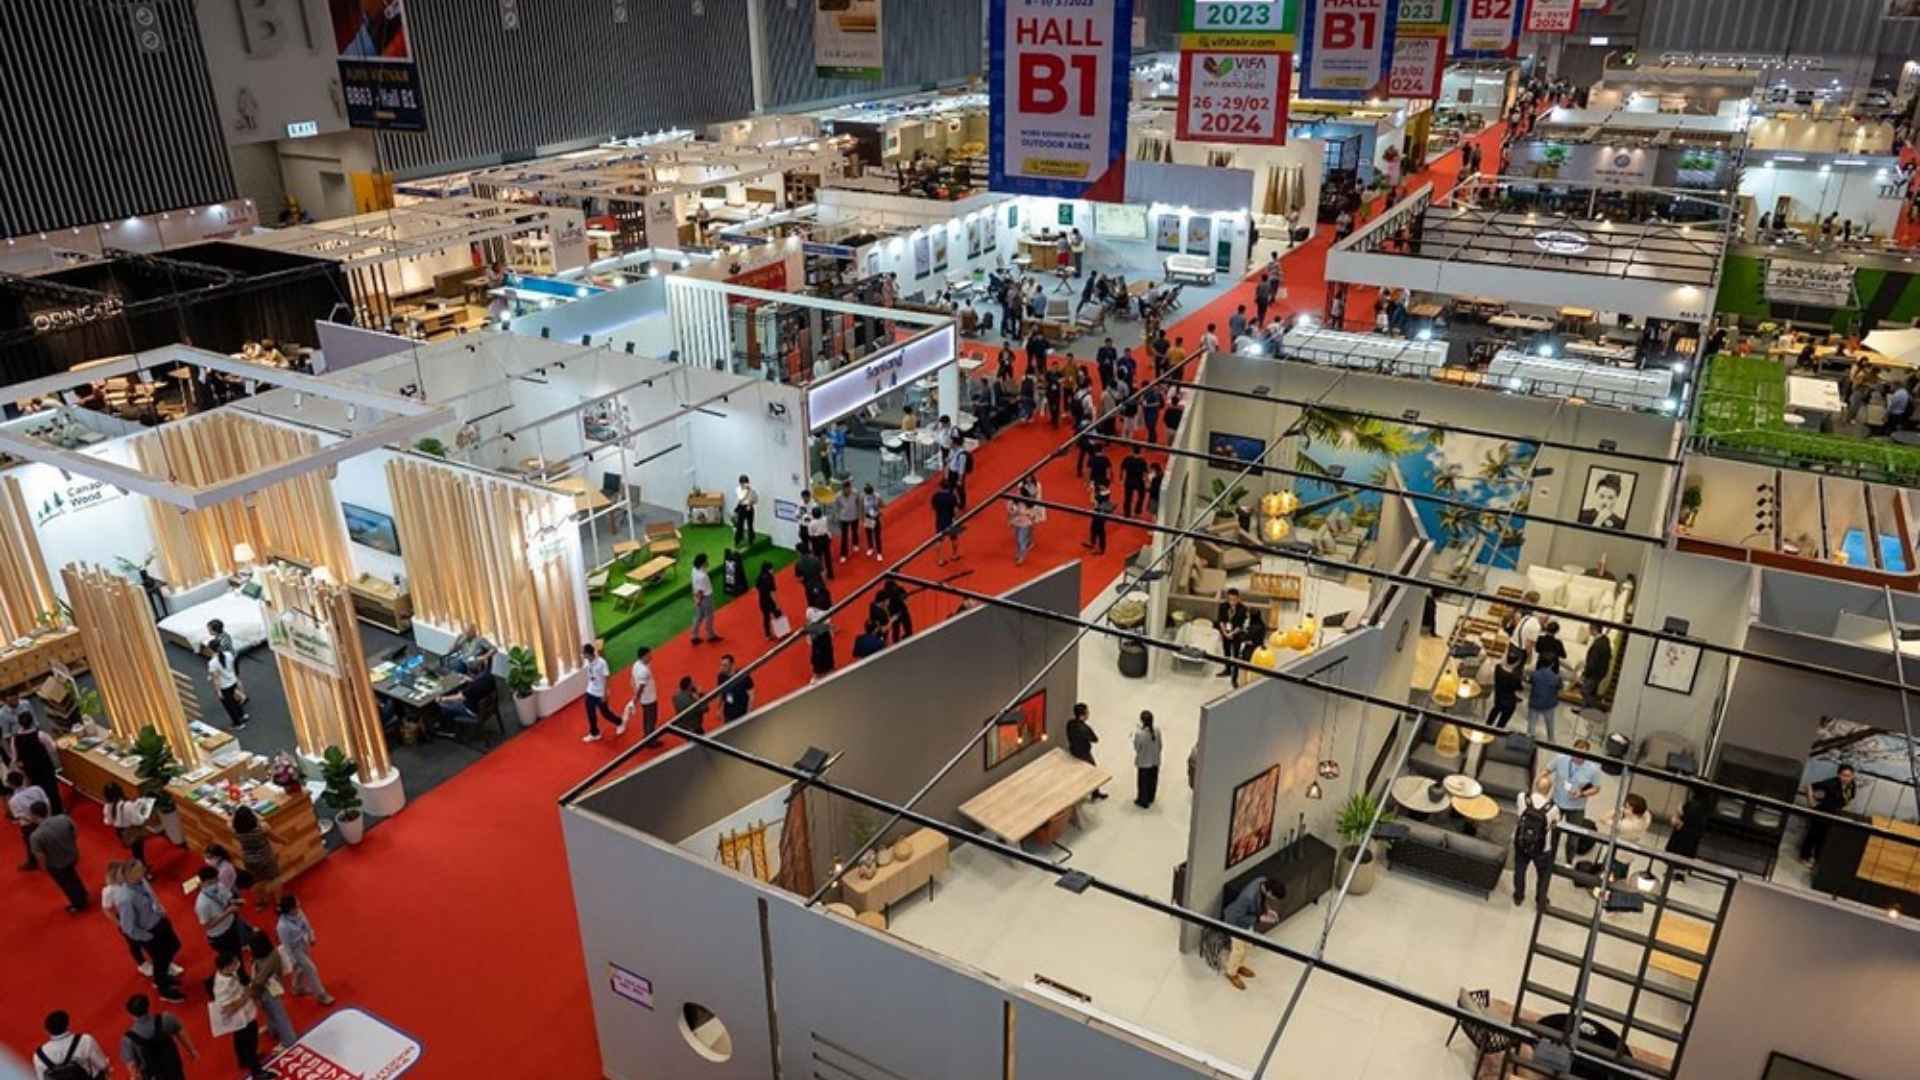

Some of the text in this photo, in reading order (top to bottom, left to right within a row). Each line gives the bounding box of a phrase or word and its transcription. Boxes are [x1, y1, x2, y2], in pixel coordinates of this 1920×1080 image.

[1207, 4, 1270, 25] 2023
[1401, 5, 1434, 18] 023
[1471, 0, 1510, 19] B2
[1016, 17, 1104, 47] HALL
[1322, 12, 1377, 50] B1
[1234, 57, 1267, 69] VIFA
[1019, 52, 1098, 117] B1
[1391, 78, 1424, 91] 024
[1193, 96, 1213, 110] 26
[1200, 112, 1263, 133] 2024
[1021, 139, 1091, 150] OUTDOOR AREA
[69, 491, 103, 507] Wood
